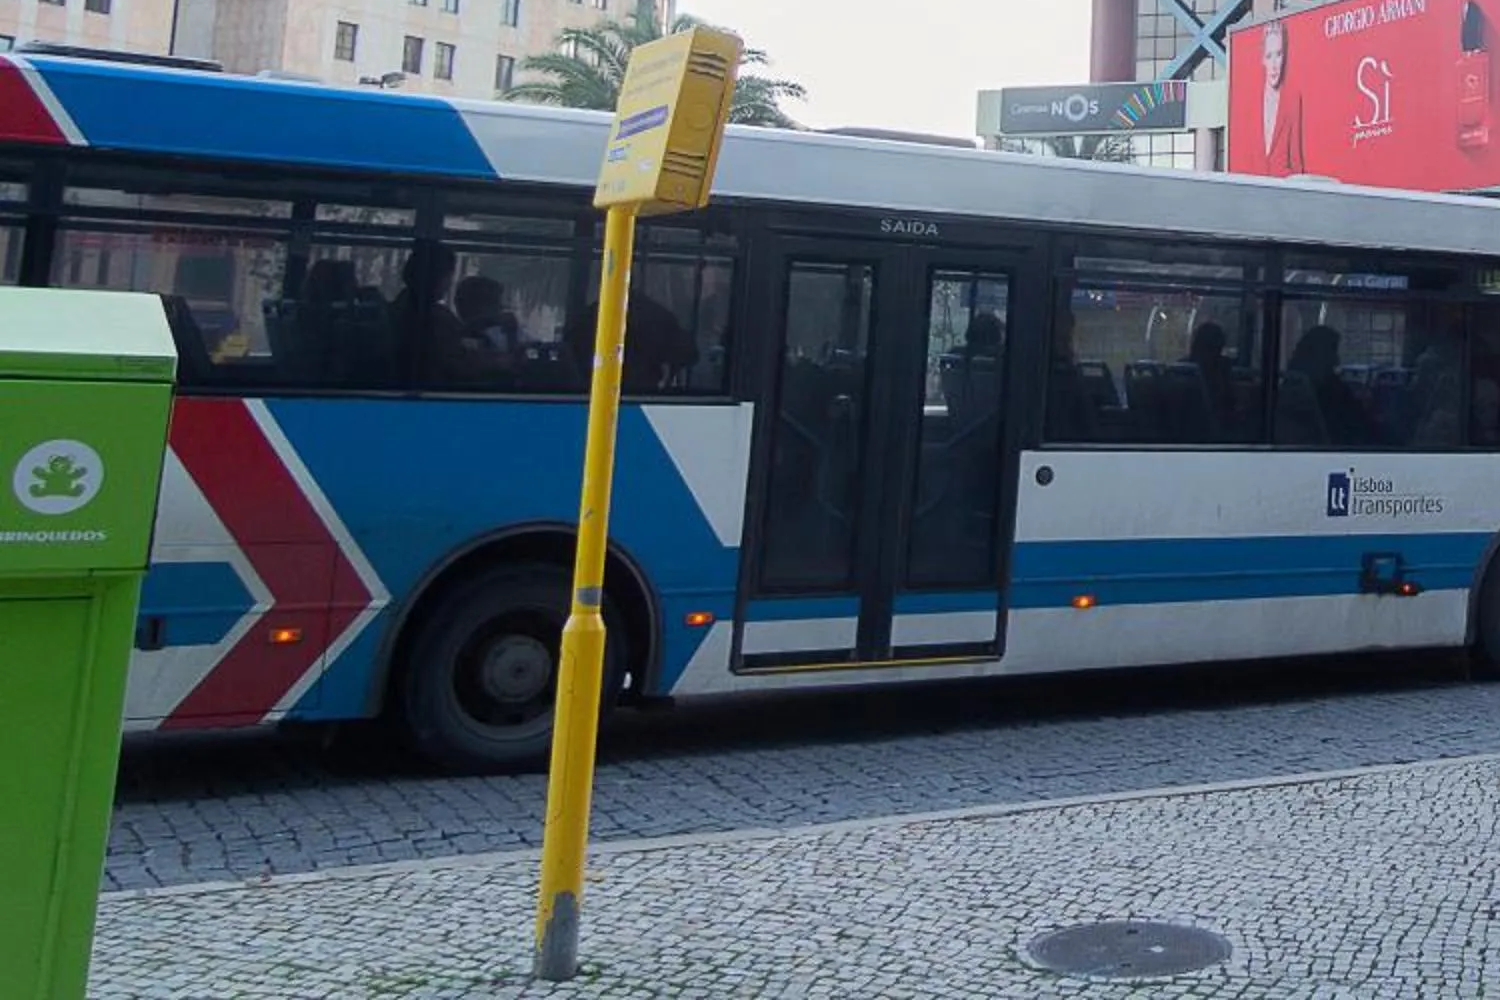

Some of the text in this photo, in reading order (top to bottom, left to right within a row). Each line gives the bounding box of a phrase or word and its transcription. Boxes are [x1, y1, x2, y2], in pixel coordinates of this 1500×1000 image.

[1324, 5, 1376, 38] GIORGIO
[1050, 93, 1099, 122] NOS
[1353, 477, 1393, 493] Lisboa
[1353, 496, 1443, 518] transportes
